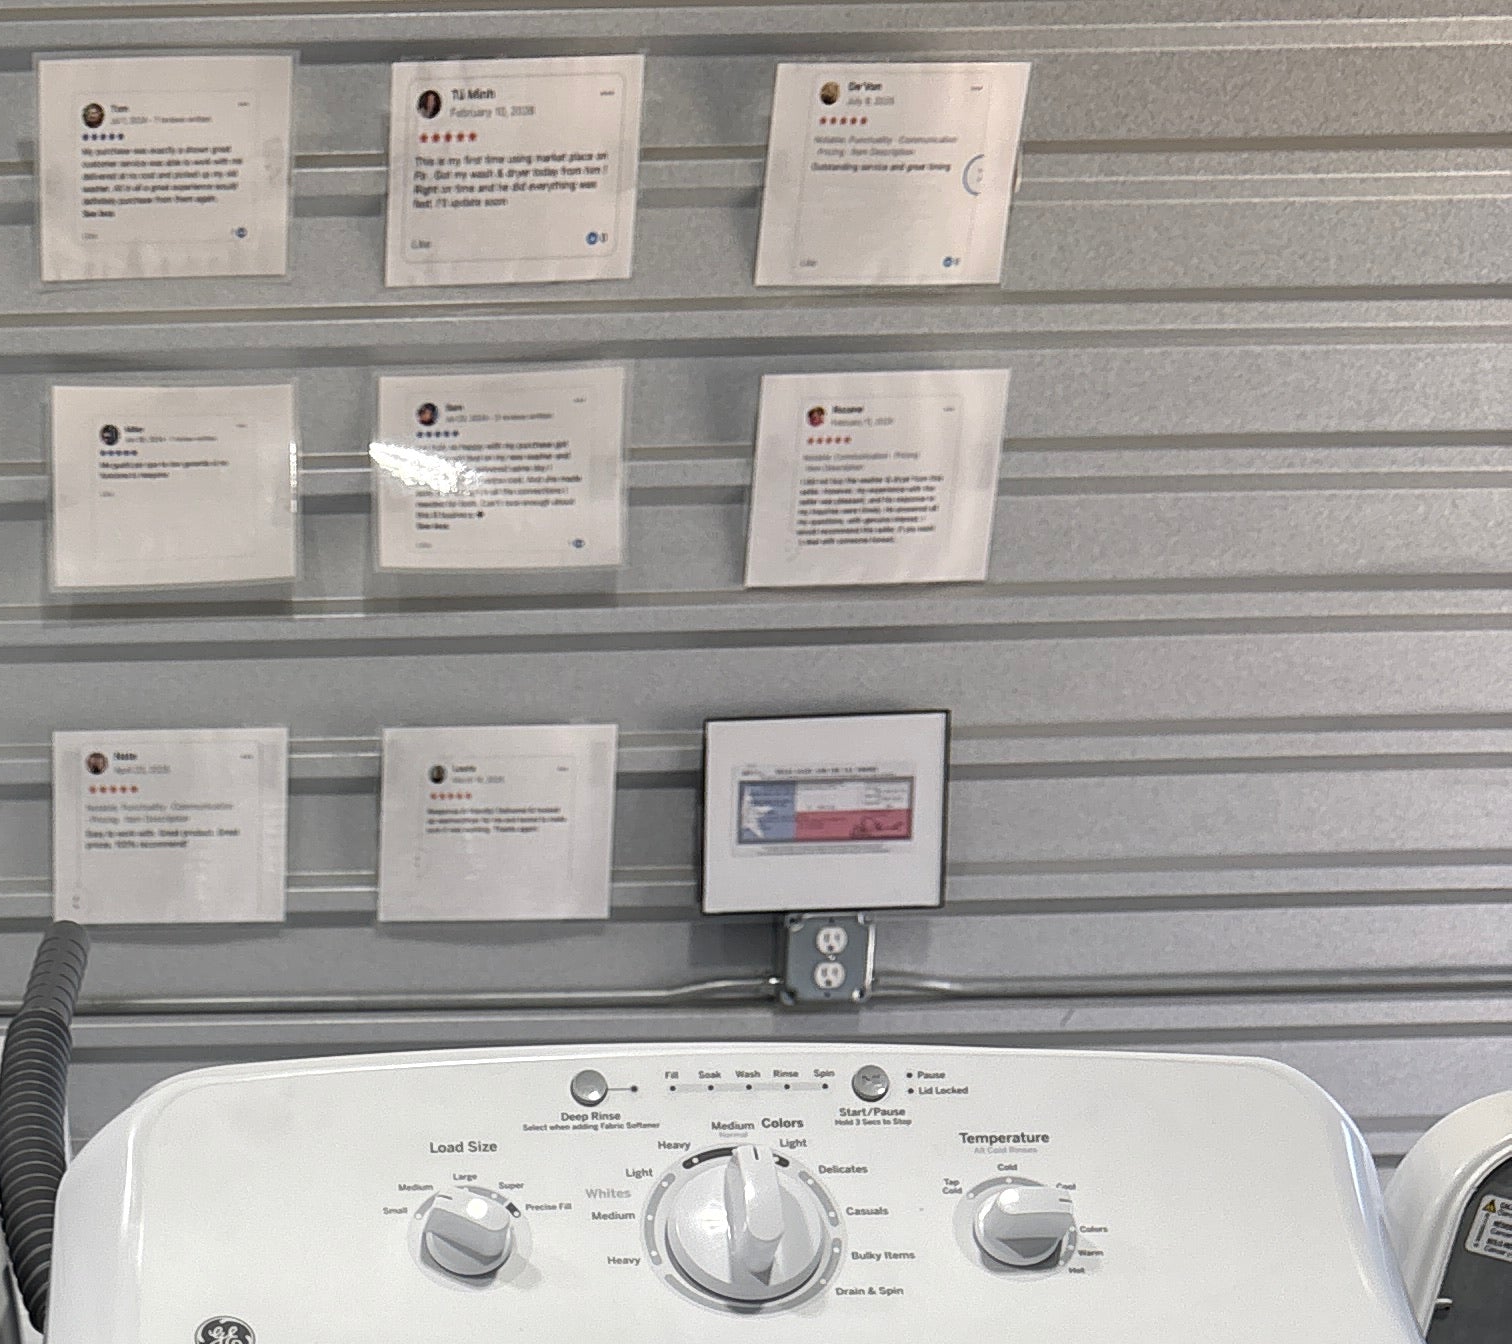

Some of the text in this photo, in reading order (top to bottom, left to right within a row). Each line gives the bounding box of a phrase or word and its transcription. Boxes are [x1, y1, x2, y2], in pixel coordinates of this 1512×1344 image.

[665, 1071, 679, 1079] Fill
[699, 1071, 721, 1079] Soak
[736, 1070, 760, 1078] Wash
[773, 1070, 799, 1078] Rinse
[814, 1069, 835, 1079] Spin
[917, 1071, 945, 1079] Pause
[919, 1086, 968, 1095] Lid Locked
[561, 1112, 621, 1122] Deep Rinse
[839, 1107, 905, 1117] Start/Pause
[571, 1123, 598, 1132] adding
[600, 1122, 624, 1130] Fabric
[712, 1121, 755, 1130] Medium
[761, 1118, 803, 1129] Colors
[779, 1138, 807, 1149] Light
[959, 1133, 1049, 1146] Temperature
[430, 1141, 498, 1153] Load Size
[658, 1140, 691, 1151] Heavy
[626, 1168, 653, 1179] Light
[818, 1164, 868, 1175] Delicates
[453, 1173, 477, 1181] Large
[499, 1182, 524, 1190] Super
[944, 1178, 959, 1187] Tap
[585, 1188, 631, 1198] Whites
[592, 1211, 635, 1220] Medium
[846, 1207, 889, 1216] Casuals
[607, 1256, 641, 1266] Heavy
[851, 1250, 915, 1262] Bulky Items
[835, 1286, 903, 1297] Drain & Spin
